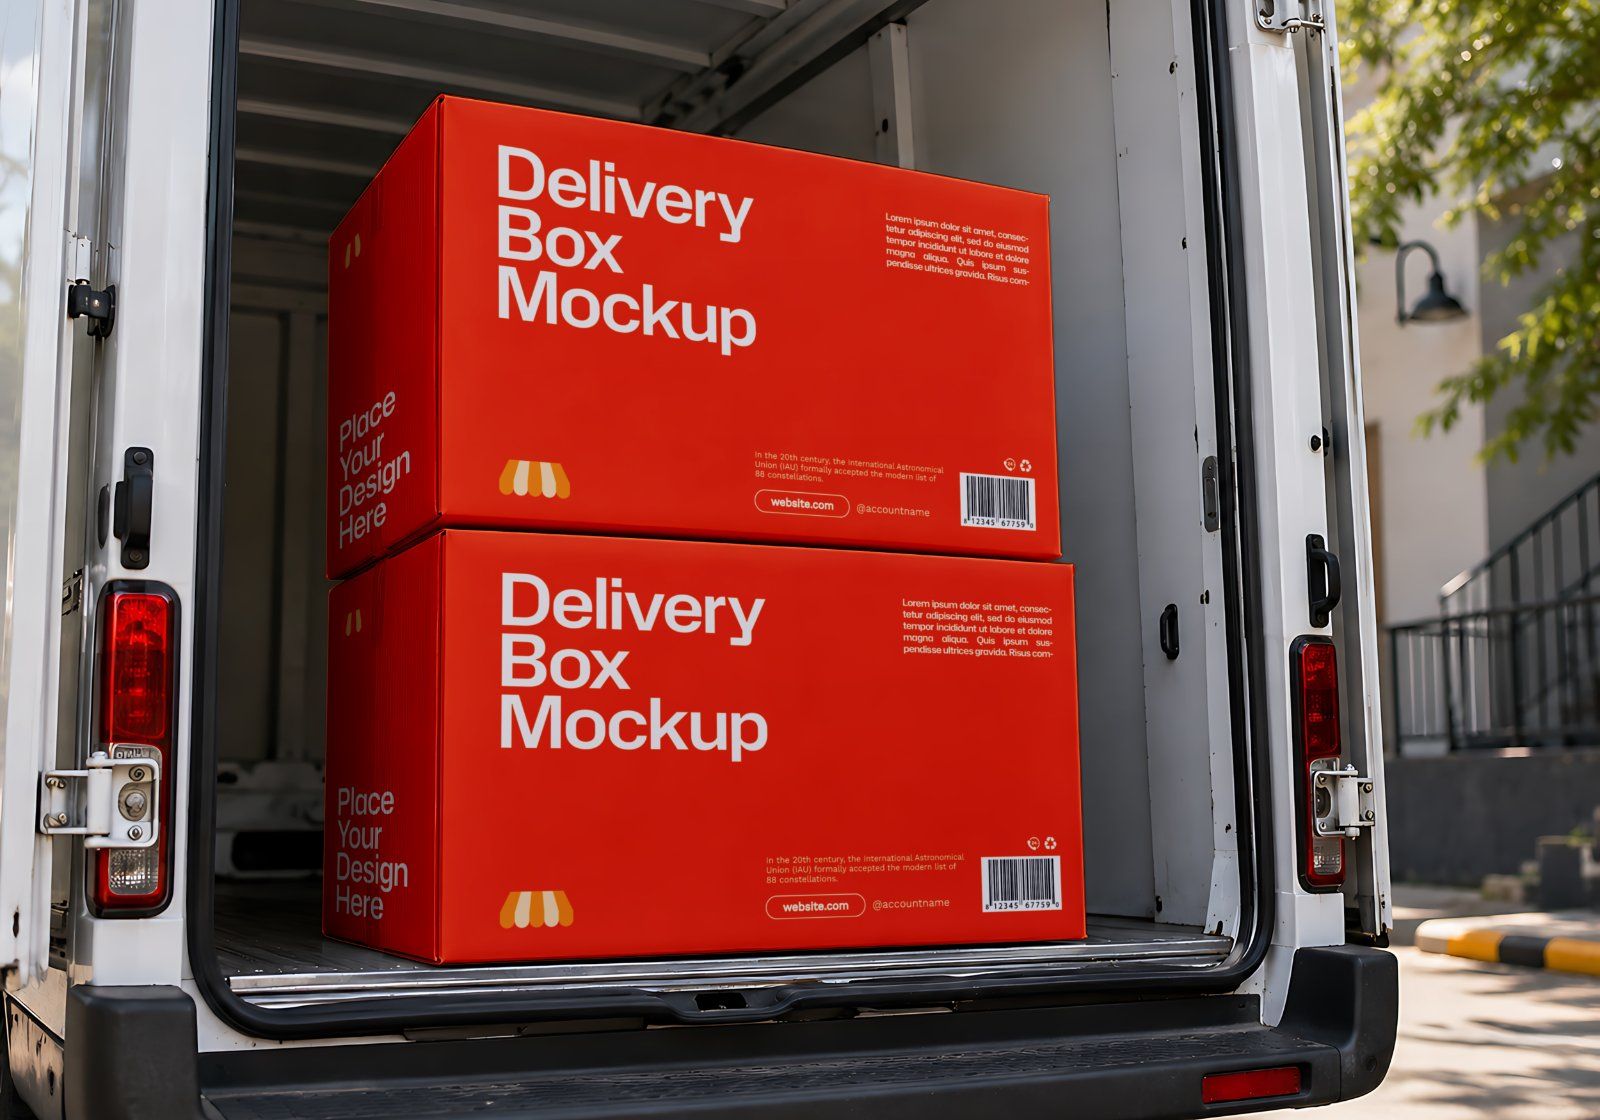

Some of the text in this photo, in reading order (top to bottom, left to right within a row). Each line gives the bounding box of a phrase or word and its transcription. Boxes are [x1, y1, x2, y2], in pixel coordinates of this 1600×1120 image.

[498, 144, 753, 242] Delivery
[498, 205, 623, 273] Box
[886, 213, 912, 224] Lorem
[914, 218, 938, 228] ipsum
[940, 221, 960, 231] dolor
[962, 224, 971, 233] sit
[998, 232, 1029, 241] consec-
[886, 225, 1029, 253] tetur adipiscing elit, sed do eiusmod
[886, 236, 1029, 264] tempor incididunt ut labore et dolore
[886, 248, 1029, 275] magna aliqua. Quis ipsum sus-
[887, 259, 1029, 286] pendisse ultrices gravida. Risus com-
[498, 266, 756, 356] Mockup
[340, 391, 395, 452] Place
[341, 432, 384, 481] Your
[780, 453, 797, 461] 20th
[833, 457, 845, 465] the
[897, 462, 944, 474] Astronomical
[340, 450, 410, 517] Design
[755, 461, 777, 469] Union
[801, 464, 831, 475] formally
[834, 468, 868, 477] accepted
[886, 471, 913, 480] modern
[929, 474, 936, 482] of
[768, 471, 823, 482] constellations.
[771, 497, 930, 517] website.com @accountname
[339, 502, 386, 549] Here
[972, 518, 995, 526] 12345
[1002, 520, 1025, 528] 67759
[502, 572, 765, 646] Delivery
[903, 599, 1051, 613] Lorem ipsum dolor sit amet, consec-
[926, 611, 968, 622] adipiscing
[970, 613, 985, 622] elit,
[987, 614, 1002, 622] sed
[1005, 615, 1015, 623] do
[1018, 616, 1052, 624] eiusmod
[903, 622, 934, 631] tempor
[937, 623, 976, 632] incididunt
[979, 625, 987, 633] ut
[990, 625, 1015, 634] labore
[1028, 627, 1052, 635] dolore
[904, 634, 933, 643] magna
[942, 635, 968, 644] aliqua.
[977, 636, 995, 644] Quis
[1004, 636, 1028, 646] ipsum
[501, 633, 630, 689] Box
[904, 645, 1053, 658] pendisse ultrices gravida. Risus com-
[500, 694, 768, 762] Mockup
[338, 787, 394, 816] Place
[338, 819, 382, 849] Your
[337, 852, 408, 892] Design
[766, 866, 789, 874] Union
[814, 865, 846, 874] formally
[849, 864, 885, 873] accepted
[903, 863, 932, 871] modern
[949, 862, 956, 870] of
[776, 856, 789, 864] the
[792, 856, 810, 864] 20th
[814, 855, 845, 864] century,
[915, 853, 964, 861] Astronomical
[766, 875, 838, 884] 88 constellations.
[336, 884, 383, 919] Here
[783, 899, 949, 912] website.com @accountname
